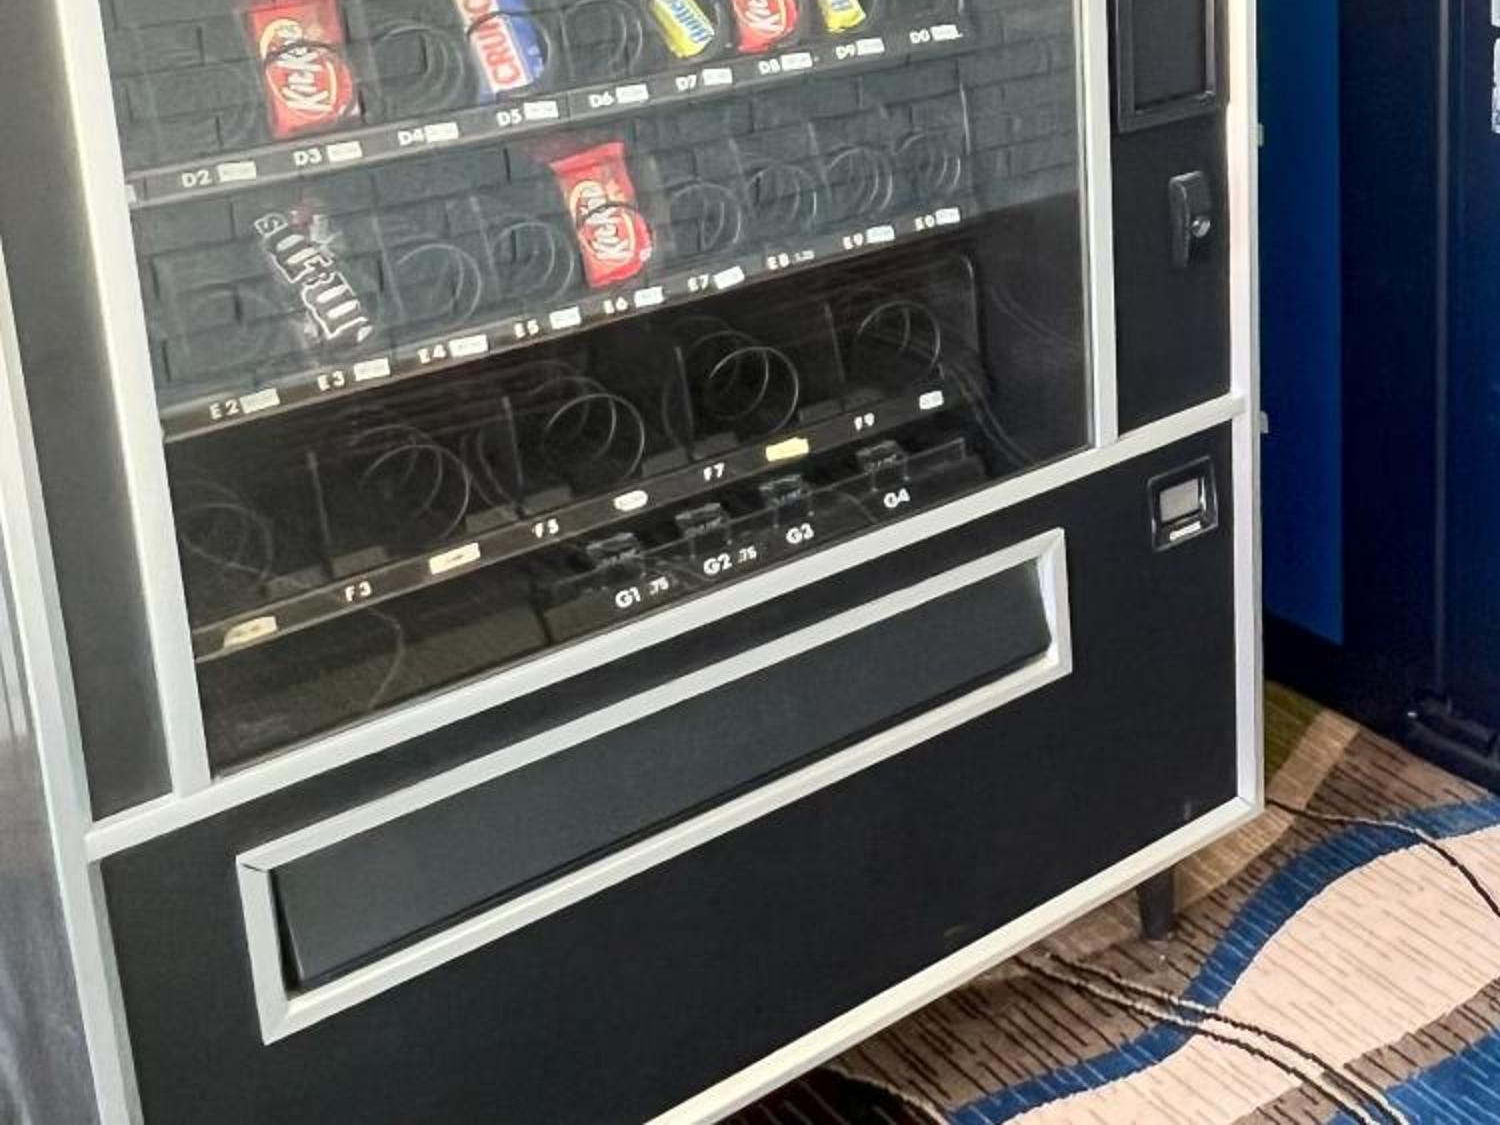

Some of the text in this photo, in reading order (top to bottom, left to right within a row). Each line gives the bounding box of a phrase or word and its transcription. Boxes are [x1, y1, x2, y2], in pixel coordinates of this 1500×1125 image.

[835, 44, 856, 60] D9
[675, 74, 697, 92] D7
[589, 92, 614, 108] D6
[496, 108, 522, 126] D5
[398, 128, 425, 146] D4
[293, 147, 323, 166] D3
[181, 169, 212, 188] D2
[687, 273, 709, 292] E7
[603, 296, 629, 314] E6
[513, 319, 539, 339] E5
[417, 344, 446, 364] E4
[317, 371, 346, 391] E3
[208, 401, 239, 421] E2
[703, 462, 725, 481] F7
[883, 487, 911, 509] G4
[534, 518, 559, 538] F5
[785, 523, 814, 545] G3
[703, 553, 733, 575] G2
[344, 581, 372, 602] F3
[614, 586, 641, 608] G1
